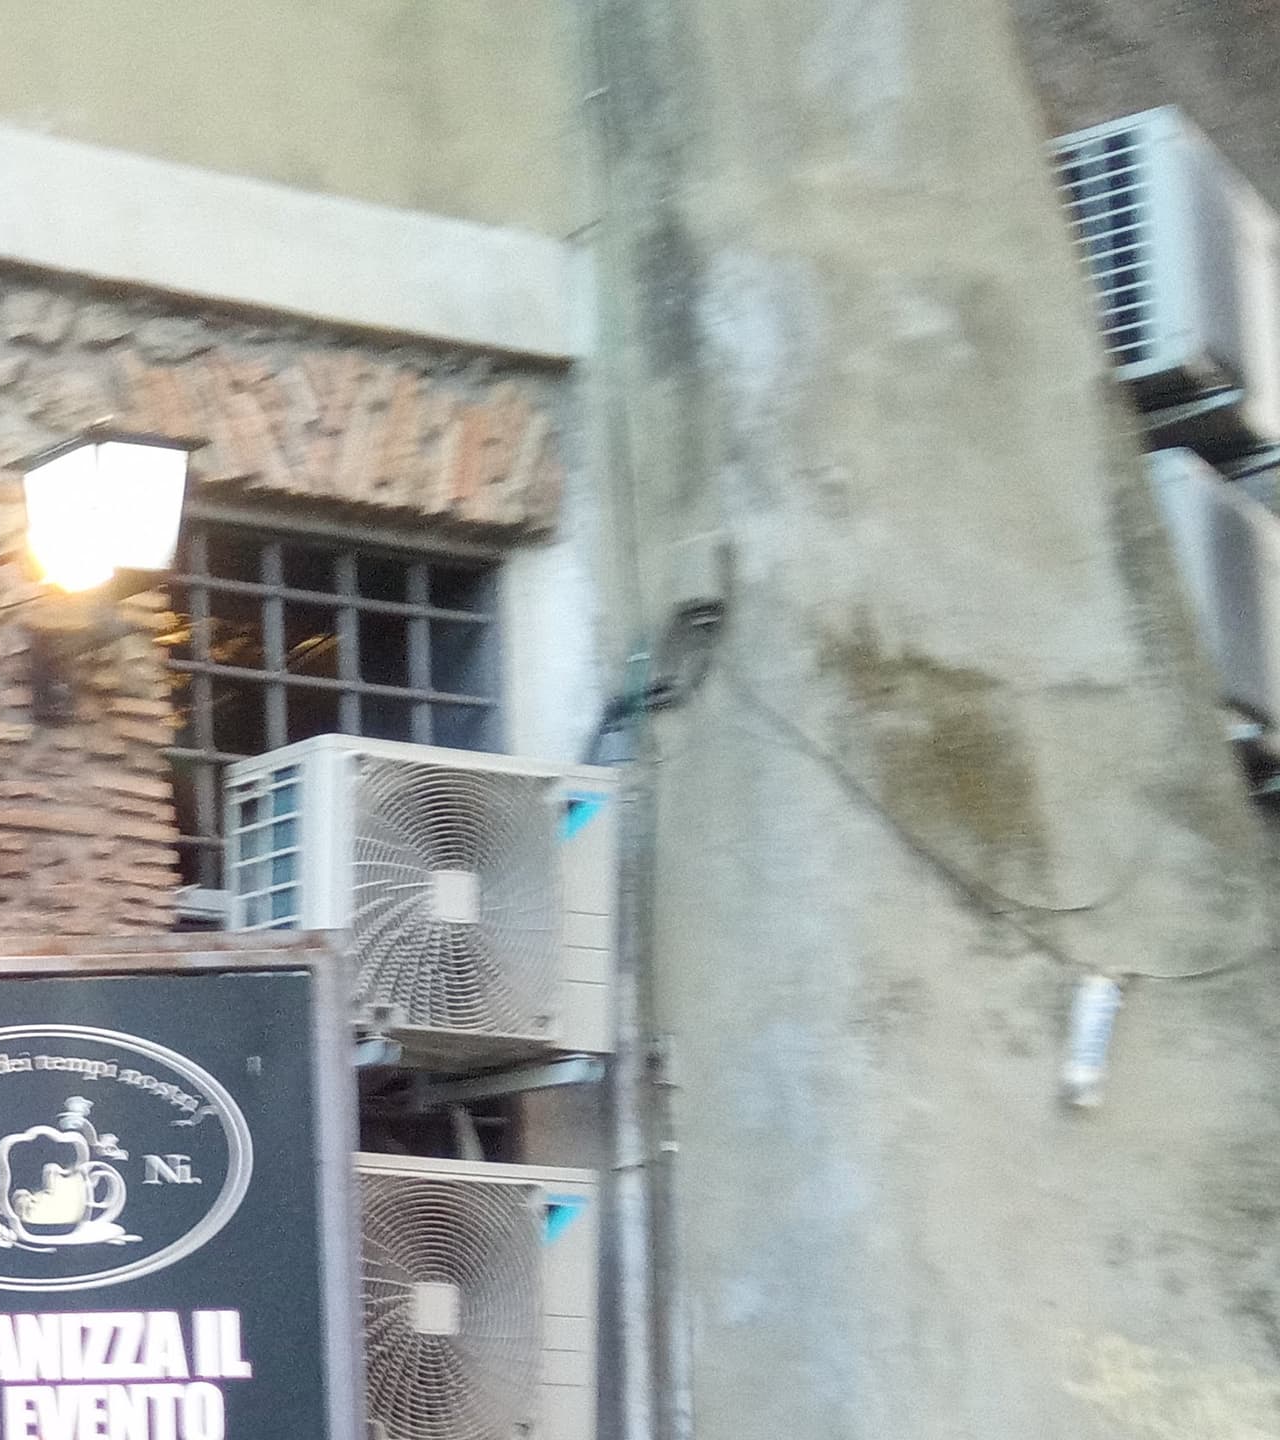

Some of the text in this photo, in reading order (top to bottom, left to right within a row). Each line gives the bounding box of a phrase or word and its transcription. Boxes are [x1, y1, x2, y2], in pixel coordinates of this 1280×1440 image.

[34, 1055, 119, 1079] tempi
[119, 1069, 200, 1112] nostri
[143, 1154, 201, 1185] Ni.
[192, 1310, 253, 1380] IL
